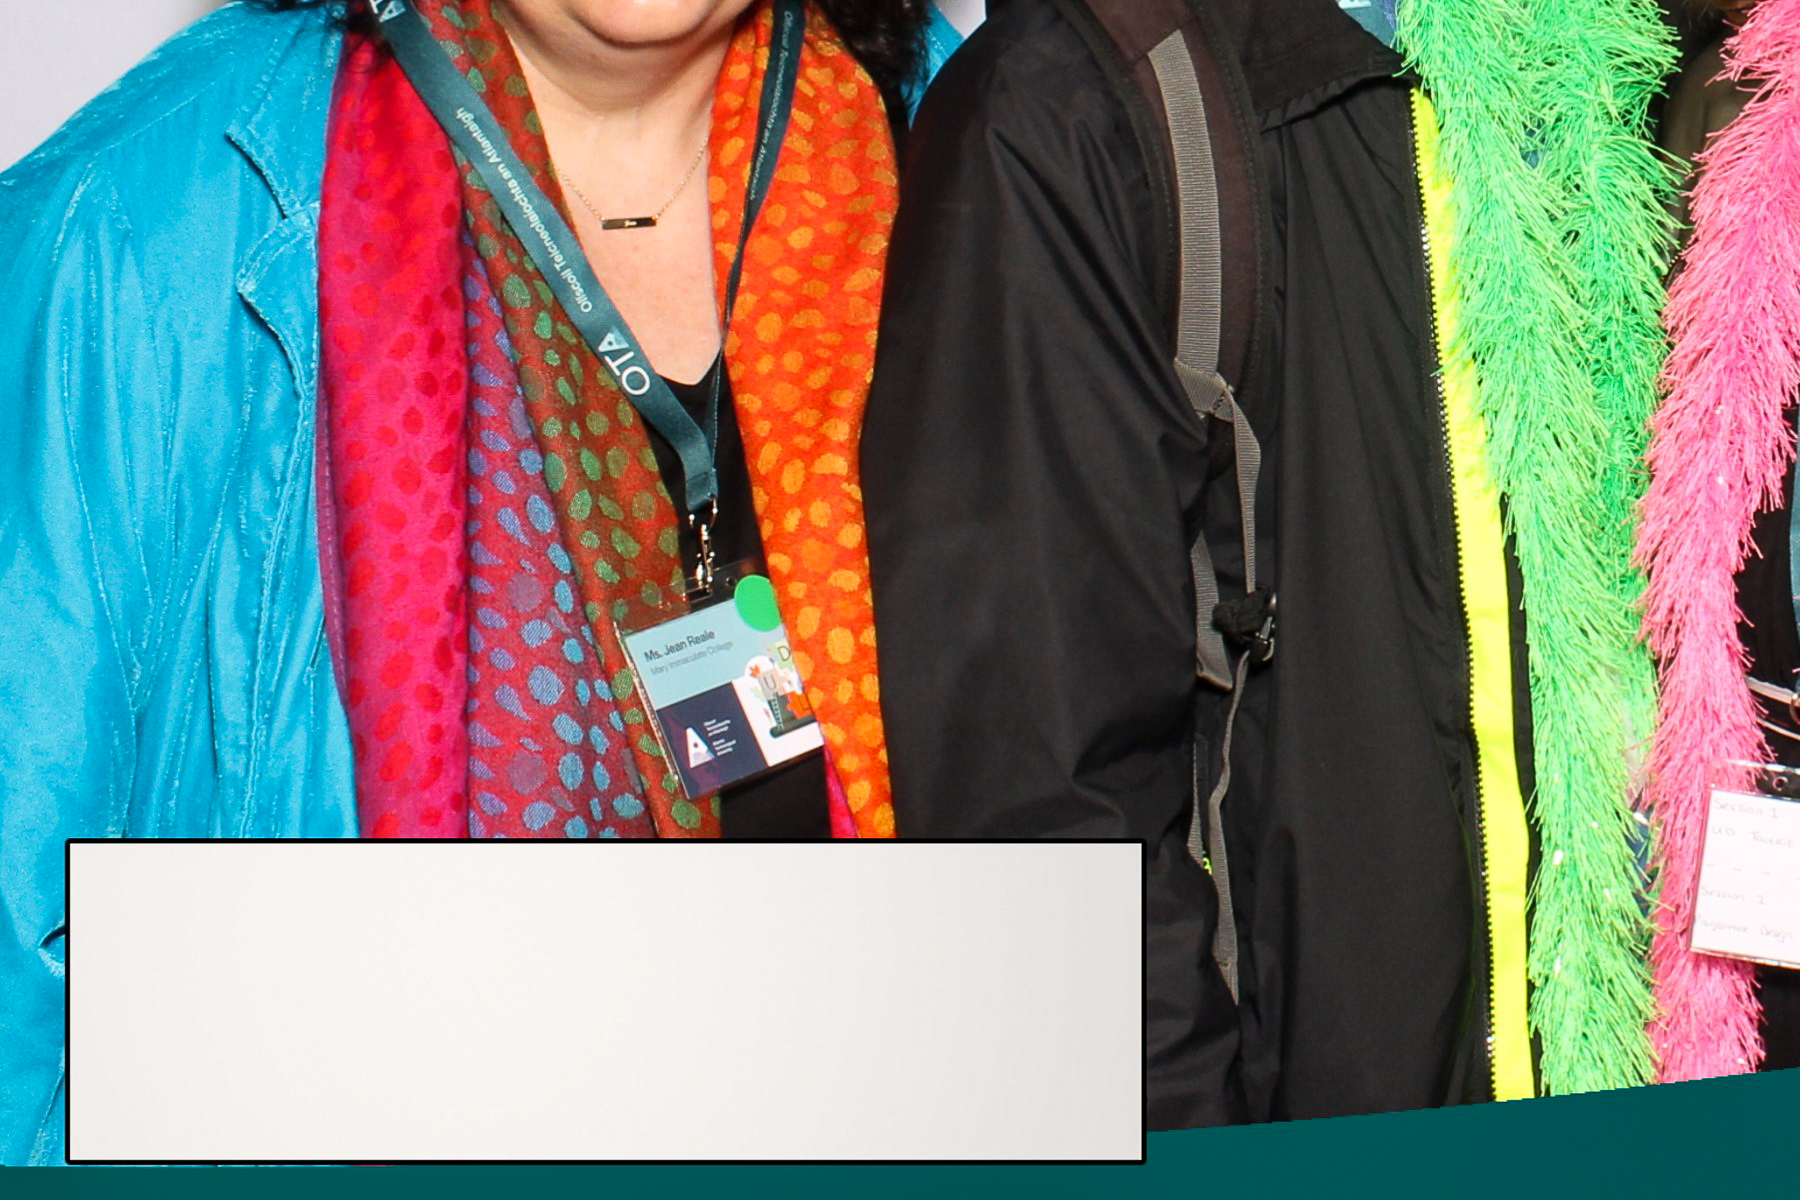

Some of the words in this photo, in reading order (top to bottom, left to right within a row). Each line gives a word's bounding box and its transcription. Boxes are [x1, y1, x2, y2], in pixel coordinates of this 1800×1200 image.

[456, 107, 502, 163] Atlantaigh
[497, 163, 512, 180] an
[560, 268, 593, 313] Ollscoil
[598, 326, 650, 396] OTA
